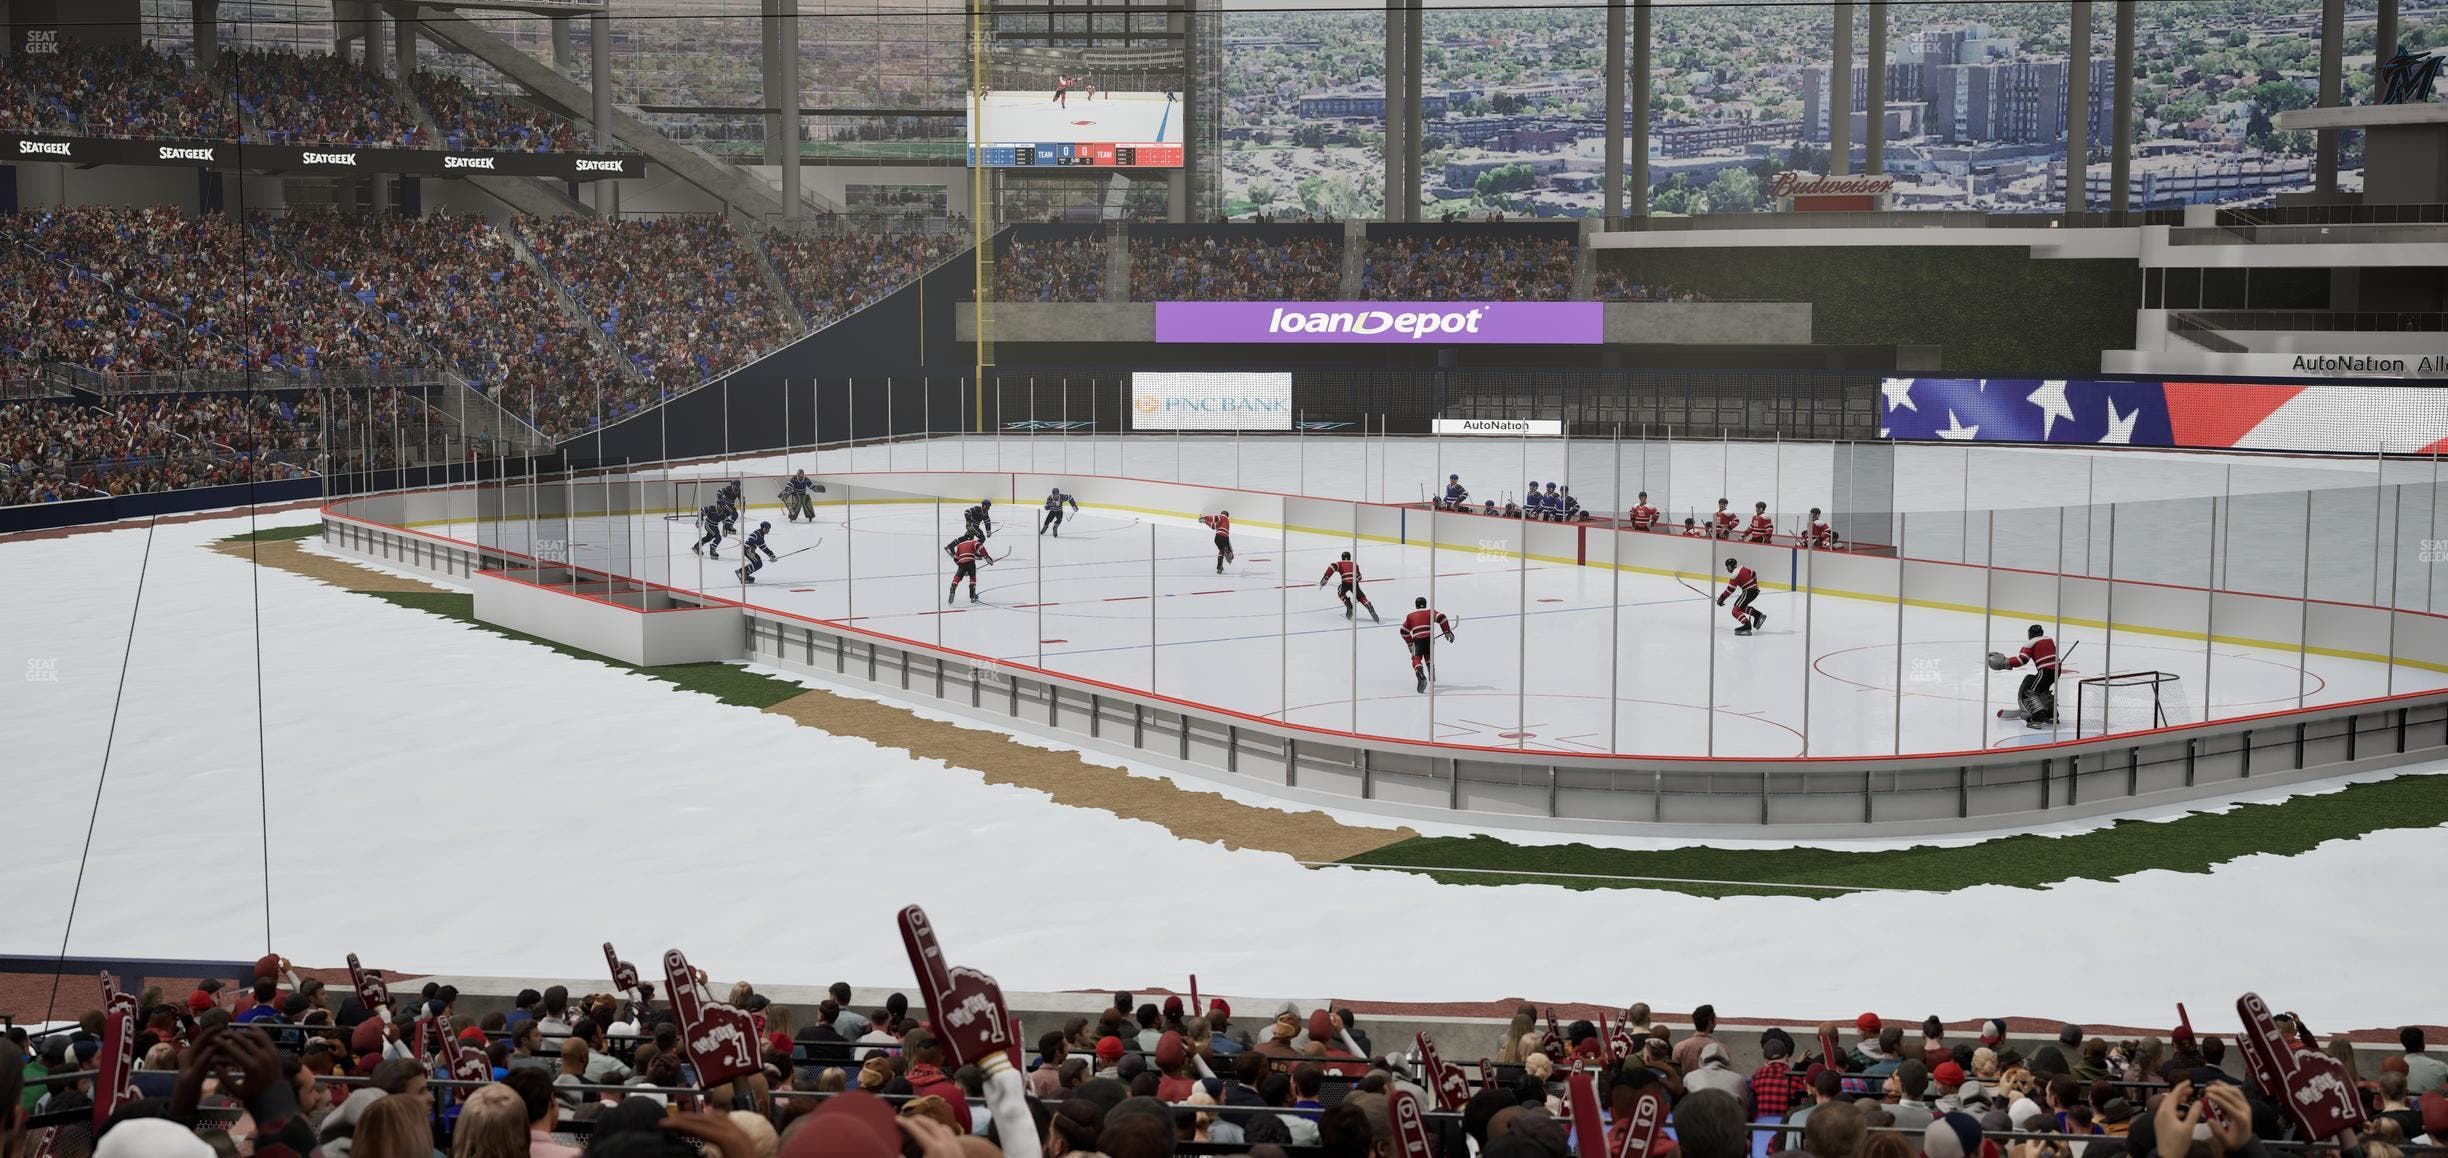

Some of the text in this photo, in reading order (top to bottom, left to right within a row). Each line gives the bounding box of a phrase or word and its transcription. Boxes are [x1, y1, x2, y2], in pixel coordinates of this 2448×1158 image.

[19, 140, 71, 156] SEATGEEK
[159, 146, 214, 161] SEATGEEK
[1063, 146, 1069, 156] 0
[1081, 146, 1088, 156] 0
[303, 152, 356, 166] SEATGEEK
[444, 156, 495, 170] SEATGEEK
[576, 159, 623, 172] SEATGEEK
[1767, 172, 1894, 198] Budweiser
[2292, 355, 2404, 372] AutoNation
[1164, 397, 1289, 412] PNC BANK
[1463, 420, 1529, 430] AutoNation
